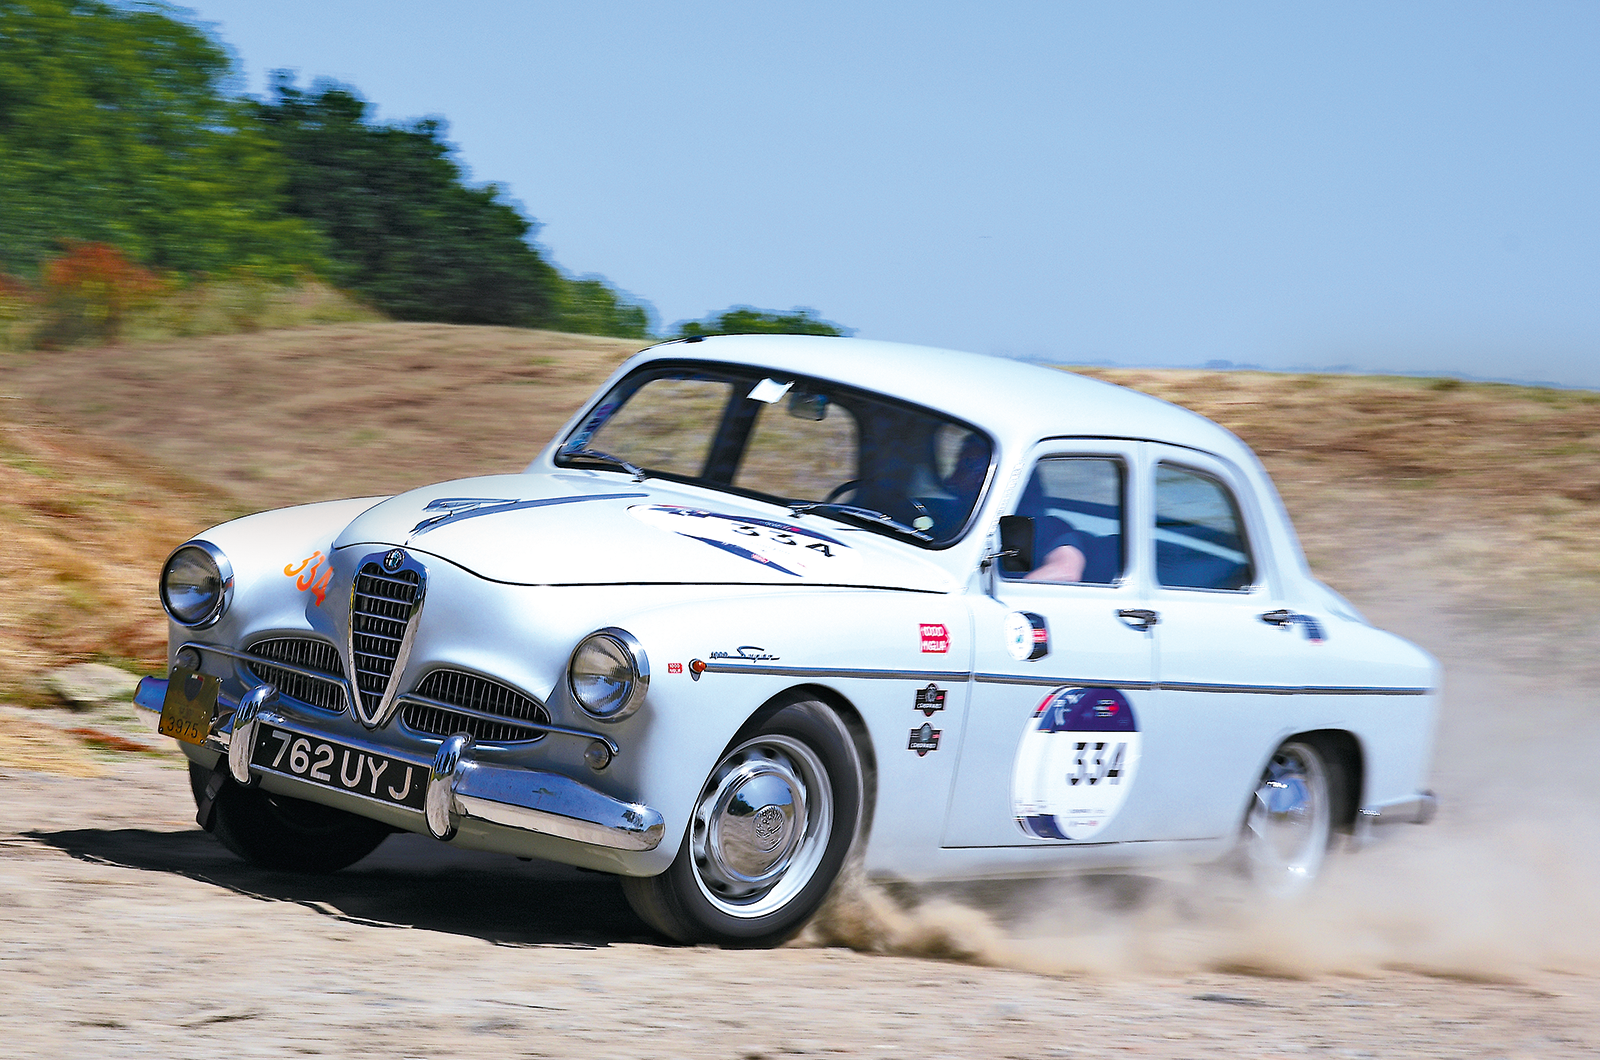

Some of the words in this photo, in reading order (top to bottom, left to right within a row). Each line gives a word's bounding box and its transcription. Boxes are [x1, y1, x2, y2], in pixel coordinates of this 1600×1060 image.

[731, 522, 836, 558] 334
[283, 550, 334, 607] 334
[167, 716, 199, 739] 3975
[1065, 742, 1128, 786] 334
